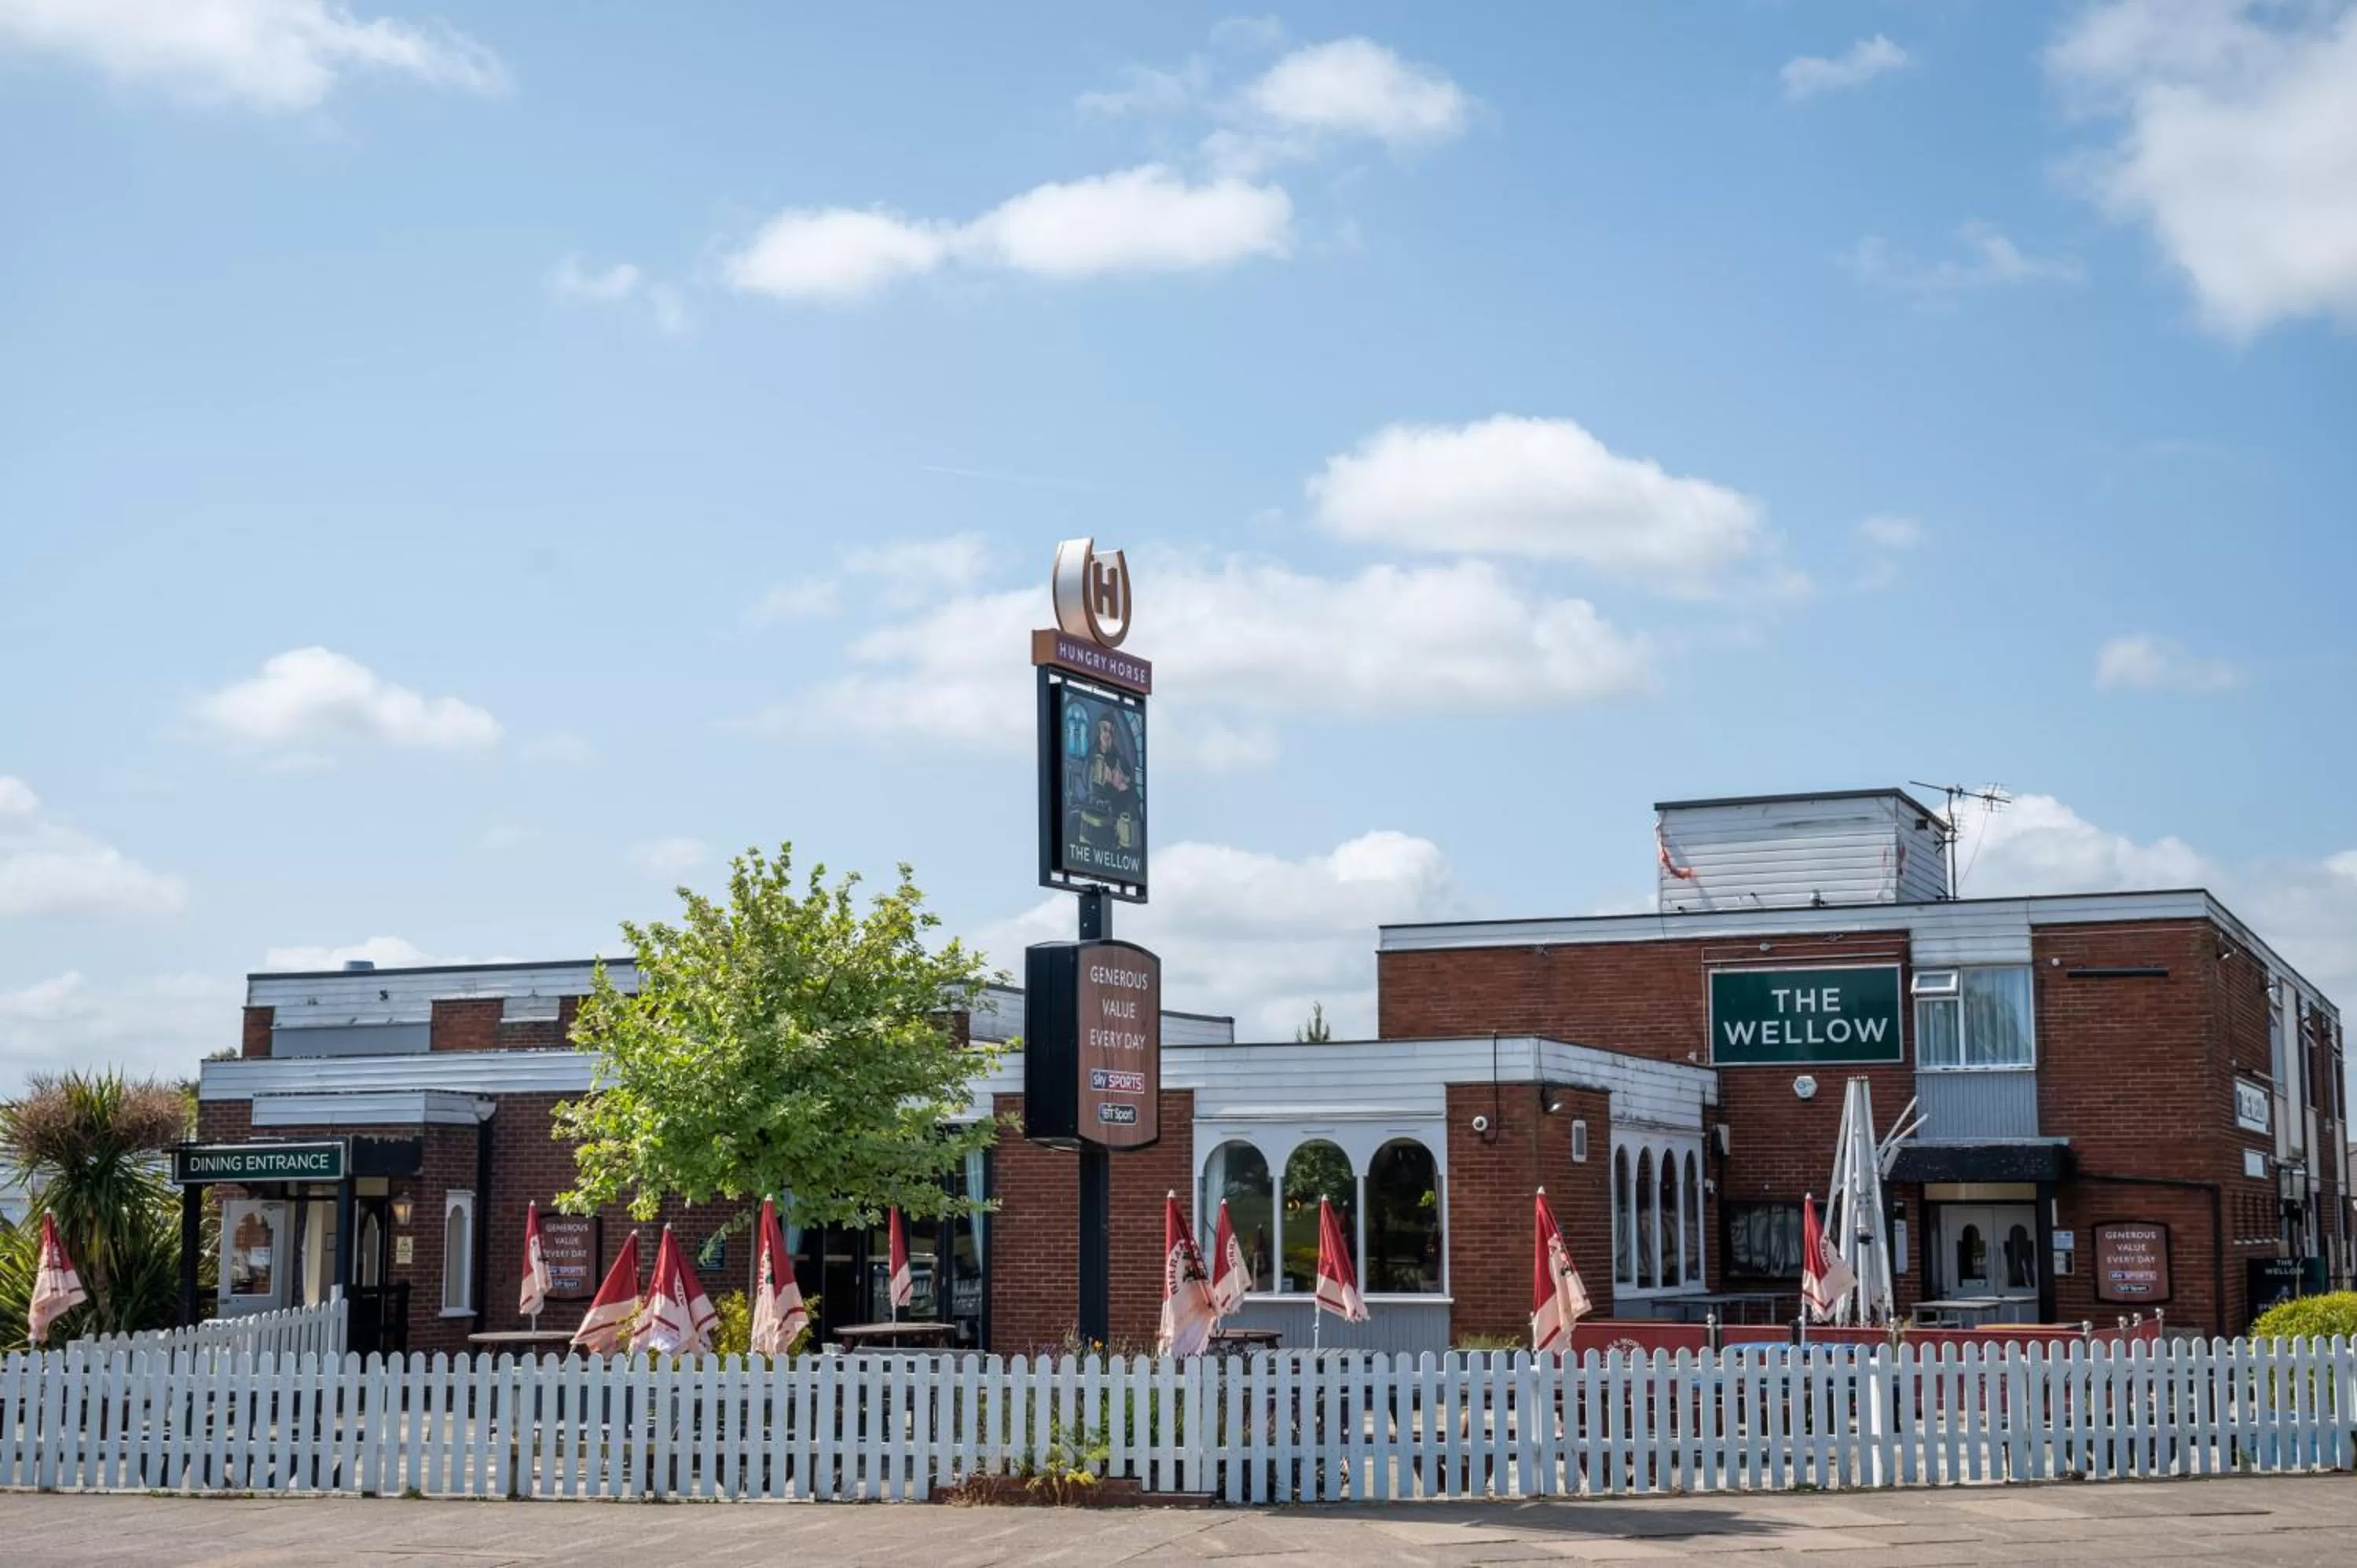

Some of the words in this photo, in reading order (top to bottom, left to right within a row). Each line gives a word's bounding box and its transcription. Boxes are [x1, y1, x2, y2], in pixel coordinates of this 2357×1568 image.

[1092, 562, 1119, 619] H
[1060, 643, 1107, 670] HUNGRY
[1109, 659, 1145, 683] HORSE
[1069, 843, 1091, 862] THE
[1093, 848, 1140, 872] WELLOW
[1090, 965, 1148, 990] GENEROUS
[1102, 998, 1136, 1018] VALUE
[1771, 987, 1841, 1013] THE
[1090, 1028, 1123, 1047] EVERY
[1124, 1032, 1146, 1050] DAY
[1723, 1018, 1888, 1046] WELLOW
[1093, 1072, 1106, 1087] sky
[1109, 1074, 1142, 1090] SPORTS
[1115, 1108, 1134, 1122] Sport
[190, 1156, 241, 1171] DINING
[246, 1154, 329, 1171] ENTRANCE
[545, 1223, 588, 1233] GENEROUS
[555, 1236, 579, 1245] VALUE
